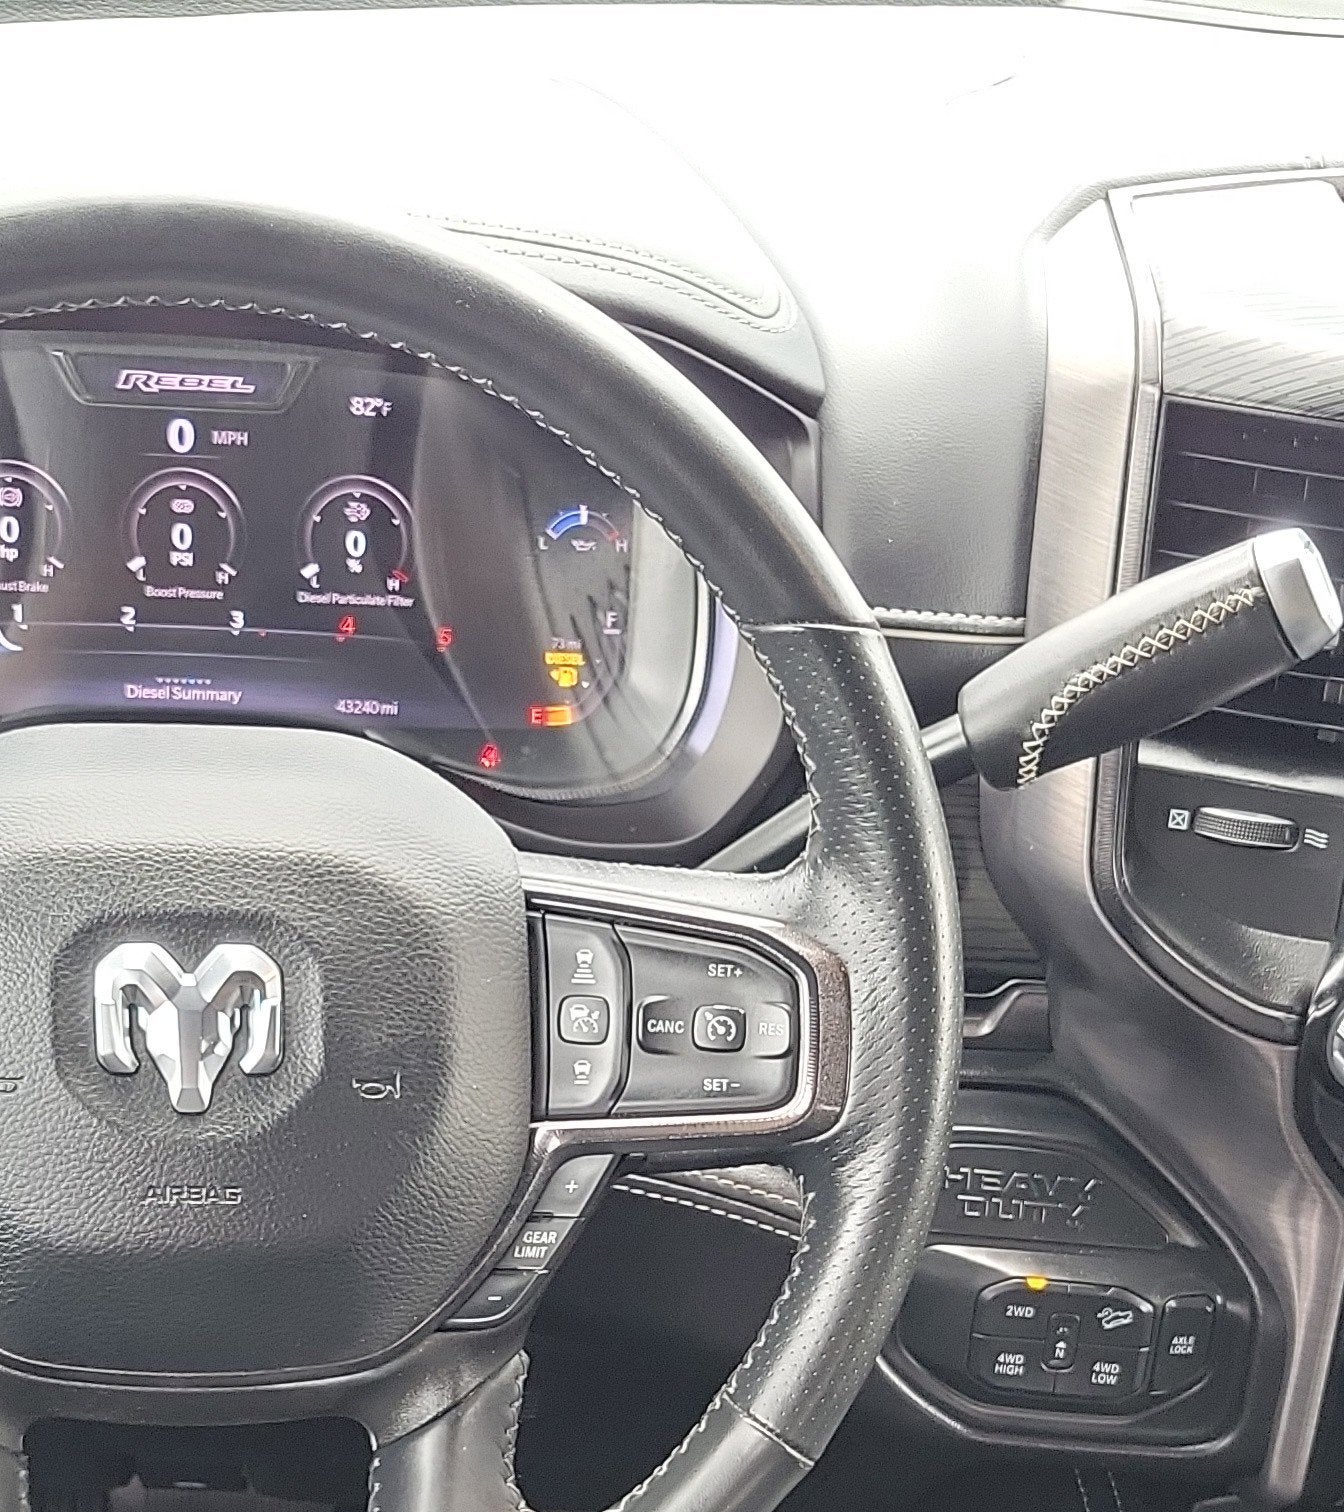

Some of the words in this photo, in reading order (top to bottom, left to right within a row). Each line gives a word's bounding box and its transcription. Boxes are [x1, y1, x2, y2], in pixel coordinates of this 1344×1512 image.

[116, 369, 256, 394] REBEL
[166, 418, 196, 454] 0
[211, 431, 249, 447] MPH
[171, 522, 192, 550] 0
[345, 530, 366, 558] 0
[169, 551, 194, 567] PSI
[18, 581, 49, 593] Brake
[144, 585, 177, 597] Boost
[178, 586, 224, 600] Pressure
[119, 605, 136, 625] 2
[230, 610, 245, 630] 3
[126, 684, 170, 701] Diesel
[171, 685, 243, 704] Summary
[336, 699, 378, 716] 43240
[380, 701, 399, 717] mi
[646, 1018, 686, 1035] CANC
[758, 1021, 786, 1037] RES
[944, 1165, 1103, 1200] HEAVY
[144, 1185, 243, 1206] AIRBAG
[522, 1230, 558, 1245] GEAR
[513, 1244, 548, 1259] LIMIT
[1006, 1305, 1035, 1318] 2WD
[1172, 1336, 1195, 1346] AXLE
[1170, 1344, 1194, 1355] LOCK
[996, 1353, 1025, 1364] 4WD
[994, 1364, 1024, 1376] HIGH
[1093, 1361, 1120, 1374] 4WD
[1091, 1373, 1118, 1385] LOW
